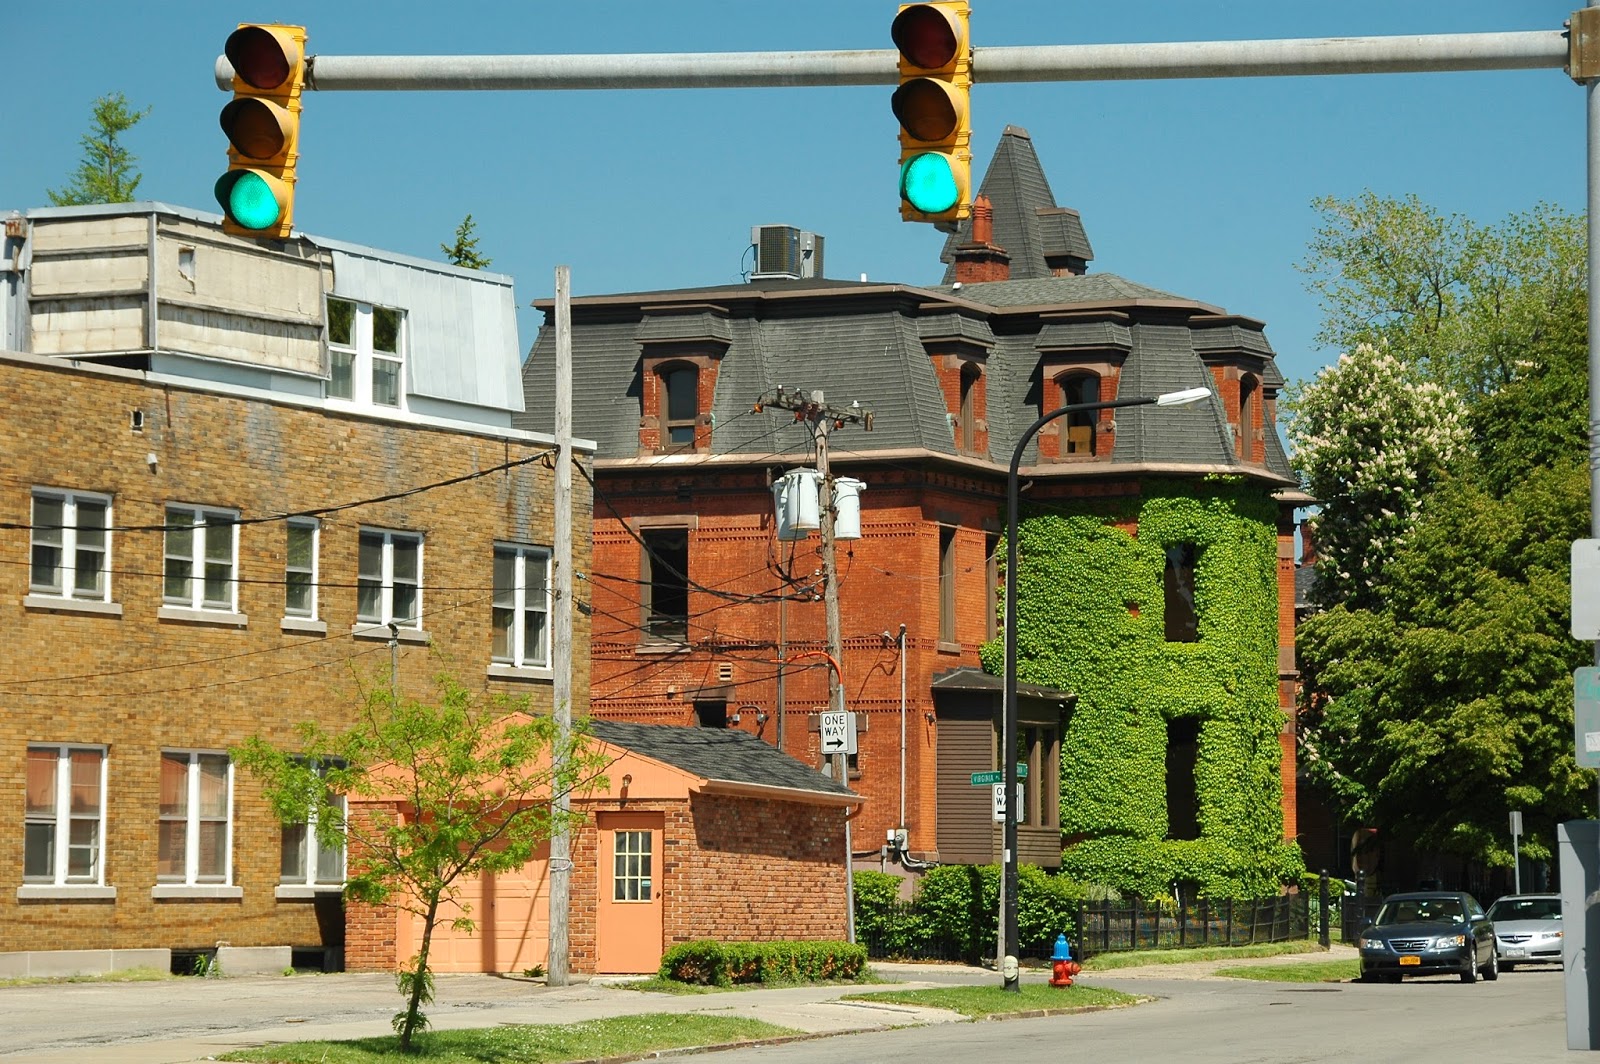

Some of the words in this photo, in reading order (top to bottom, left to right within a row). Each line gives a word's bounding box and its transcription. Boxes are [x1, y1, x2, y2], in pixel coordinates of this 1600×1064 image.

[824, 715, 845, 725] ONE
[824, 726, 846, 736] WAY
[973, 774, 994, 783] VIRGINIA
